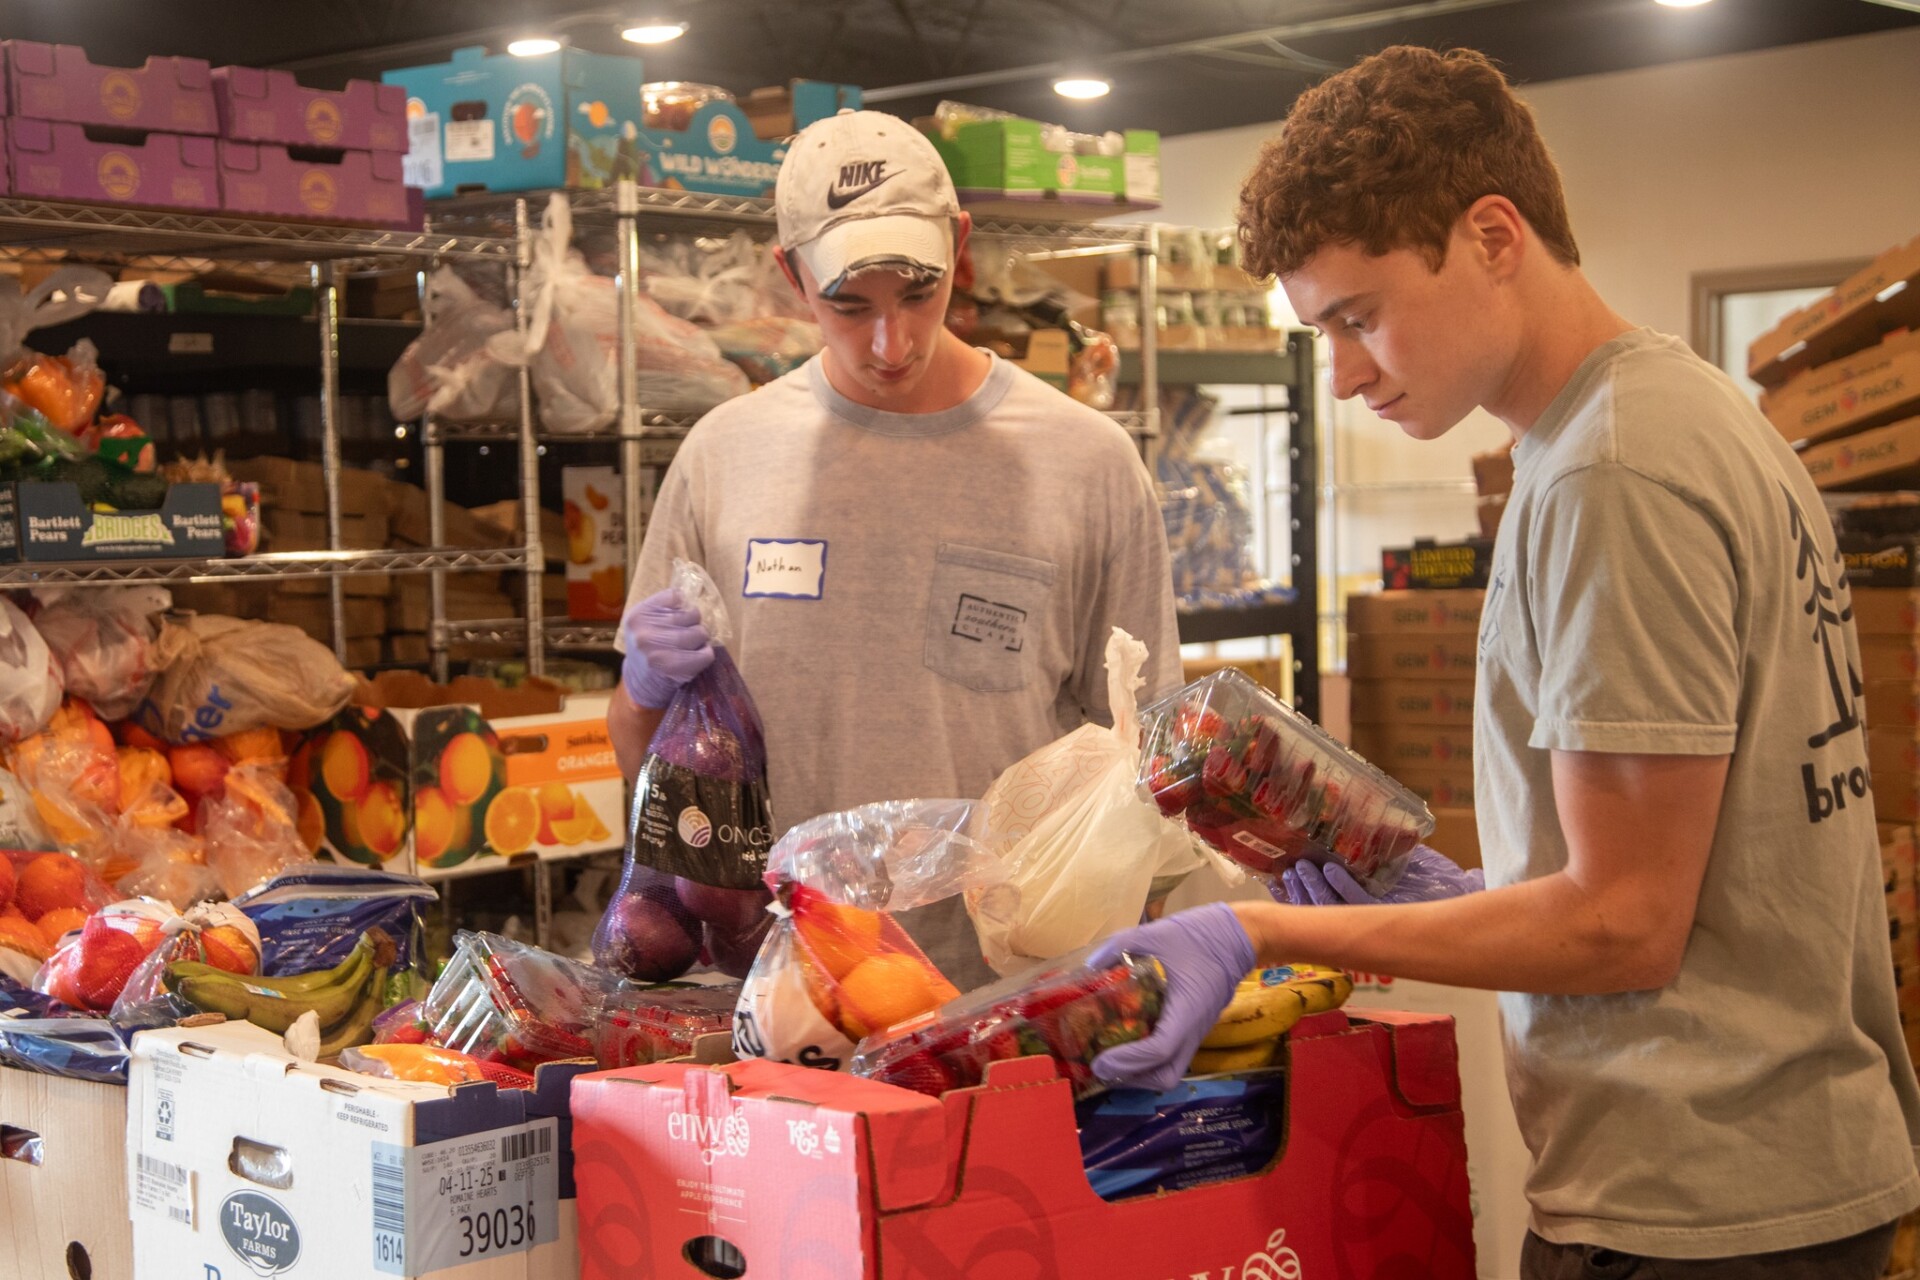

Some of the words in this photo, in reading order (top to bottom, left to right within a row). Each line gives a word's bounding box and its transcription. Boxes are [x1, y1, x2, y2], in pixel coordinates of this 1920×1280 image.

[838, 160, 887, 188] NIKE
[1862, 375, 1905, 401] PACK
[28, 516, 81, 529] Bartlett
[94, 514, 161, 540] BRIDGES
[172, 514, 220, 527] Bartlett
[30, 528, 68, 542] Pears
[187, 527, 221, 539] Pears
[756, 556, 802, 574] Nathan
[650, 784, 660, 798] 5
[344, 1103, 376, 1118] PERISHABLE
[336, 1112, 349, 1122] KEEP
[350, 1115, 389, 1132] REFRIGERATED
[668, 1112, 727, 1166] envy
[440, 1166, 493, 1196] 04-11-25
[677, 1178, 698, 1190] ENJOY
[450, 1190, 474, 1204] ROMAINE
[476, 1186, 498, 1200] HEARTS
[680, 1190, 701, 1201] APPLE
[456, 1203, 472, 1215] PACK
[230, 1201, 291, 1242] Taylor
[459, 1200, 536, 1257] 39036
[242, 1238, 277, 1259] FARMS
[375, 1232, 404, 1266] 1614
